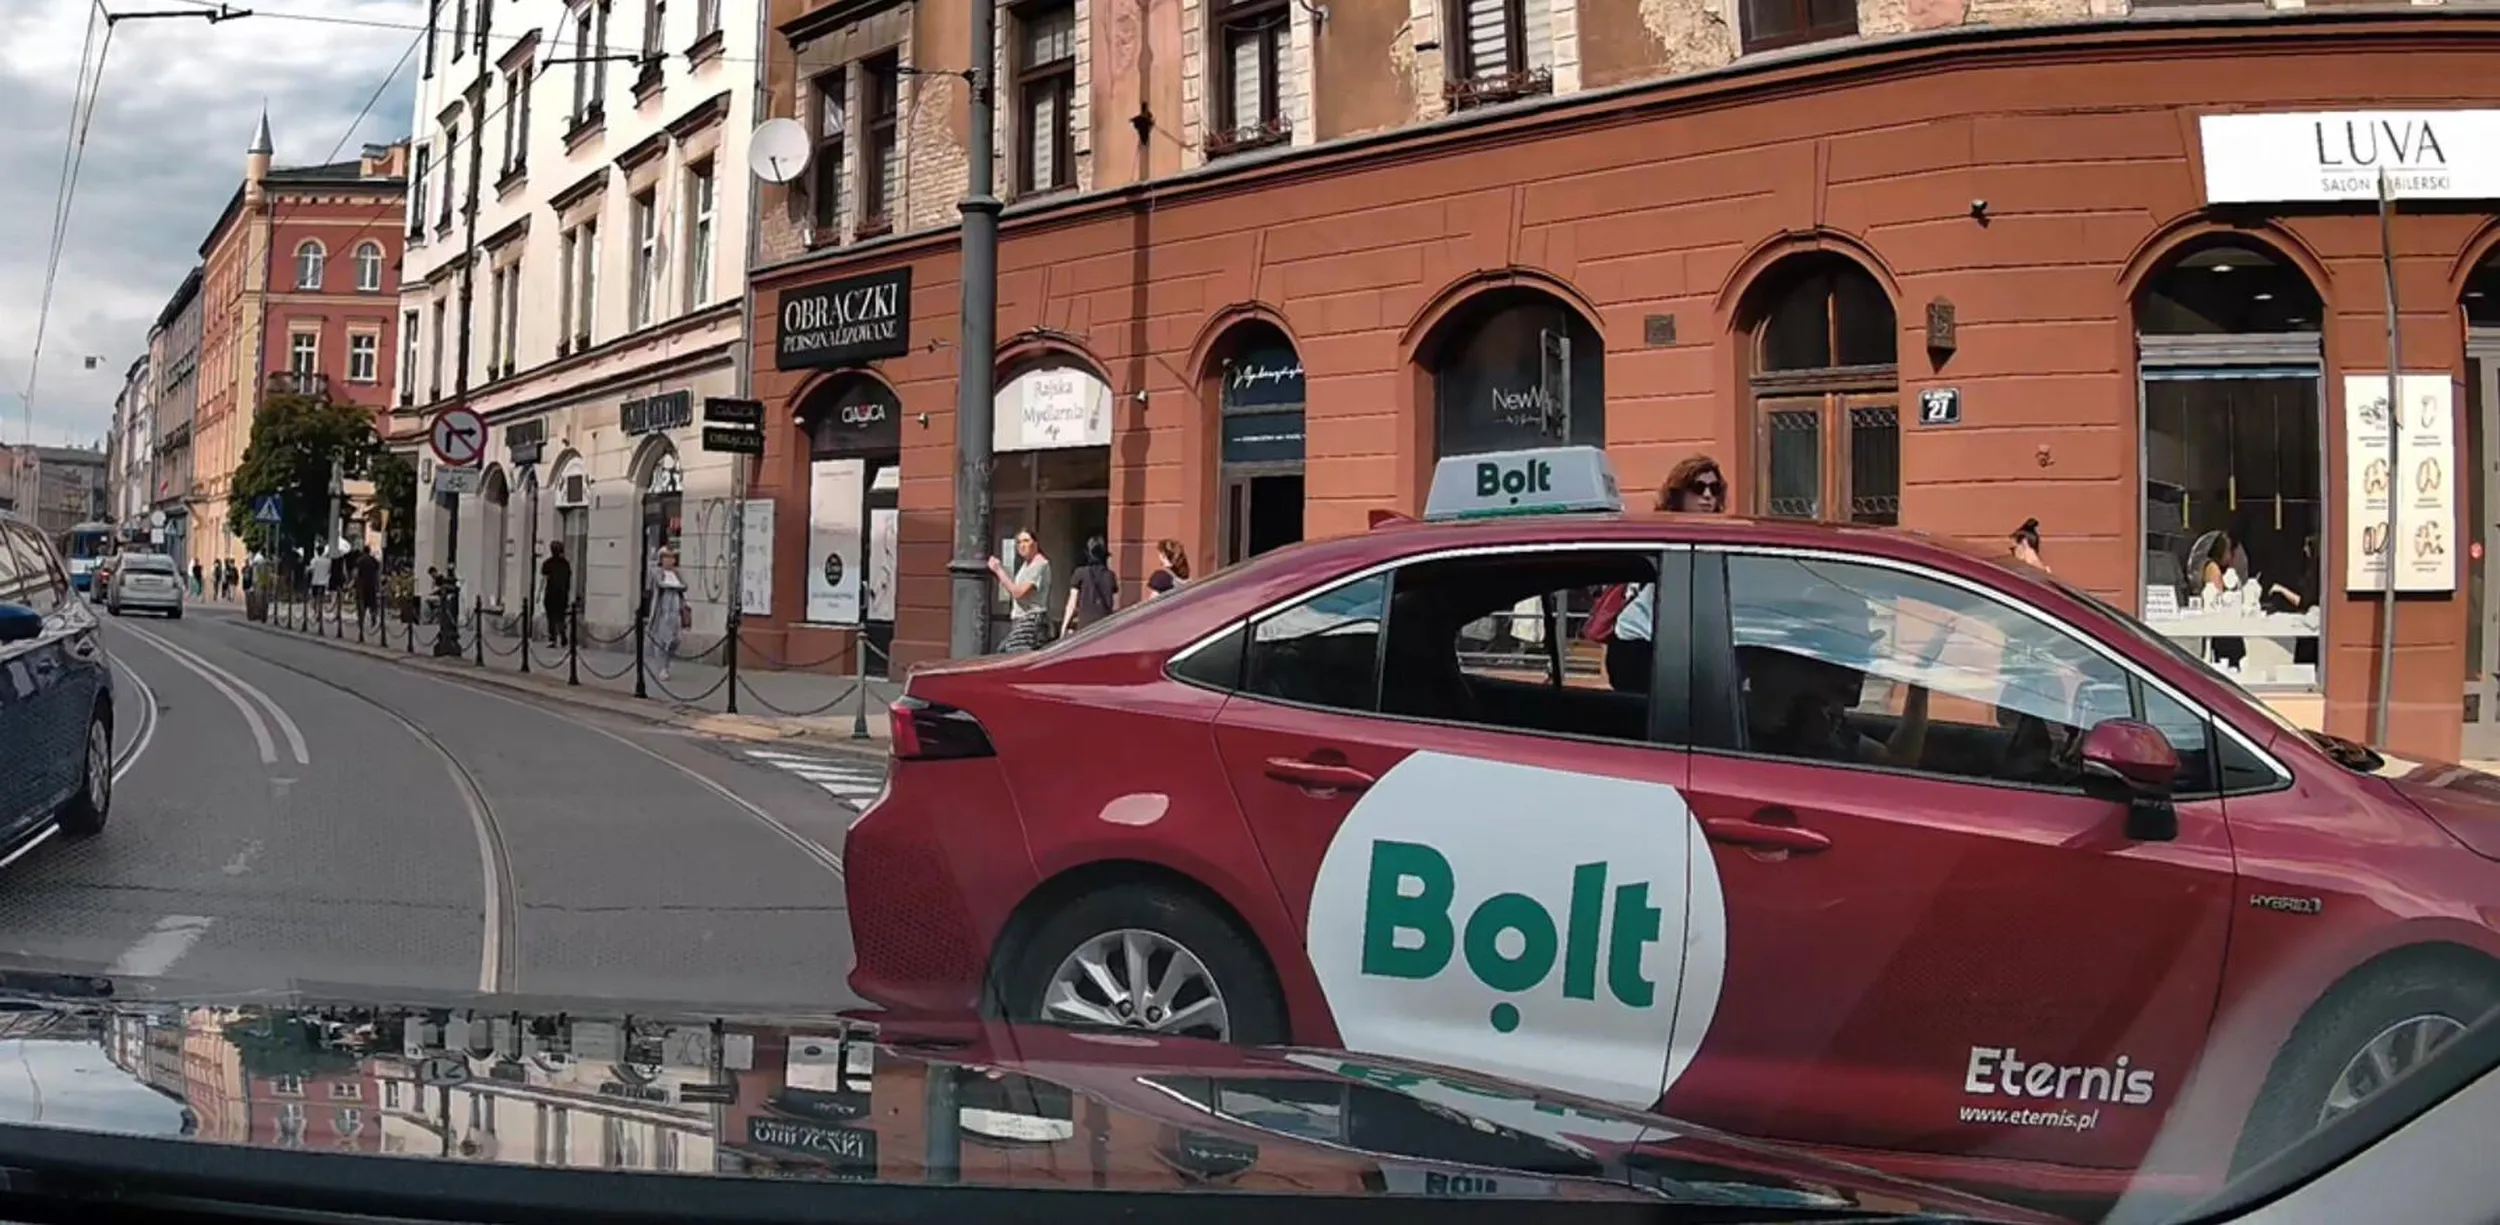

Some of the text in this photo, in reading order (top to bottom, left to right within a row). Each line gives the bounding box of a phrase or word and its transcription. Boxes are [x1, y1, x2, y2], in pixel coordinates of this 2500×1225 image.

[2315, 120, 2446, 165] LUVA
[2320, 178, 2371, 192] SALON
[783, 282, 899, 334] OBRĄCZKI
[1034, 379, 1074, 399] Rajska
[1928, 399, 1949, 419] 27
[1476, 459, 1552, 504] Bolt
[1361, 839, 1662, 1034] Bolt
[1964, 1045, 2155, 1104] Eternis
[1959, 1104, 2099, 1132] www.eternis.pl
